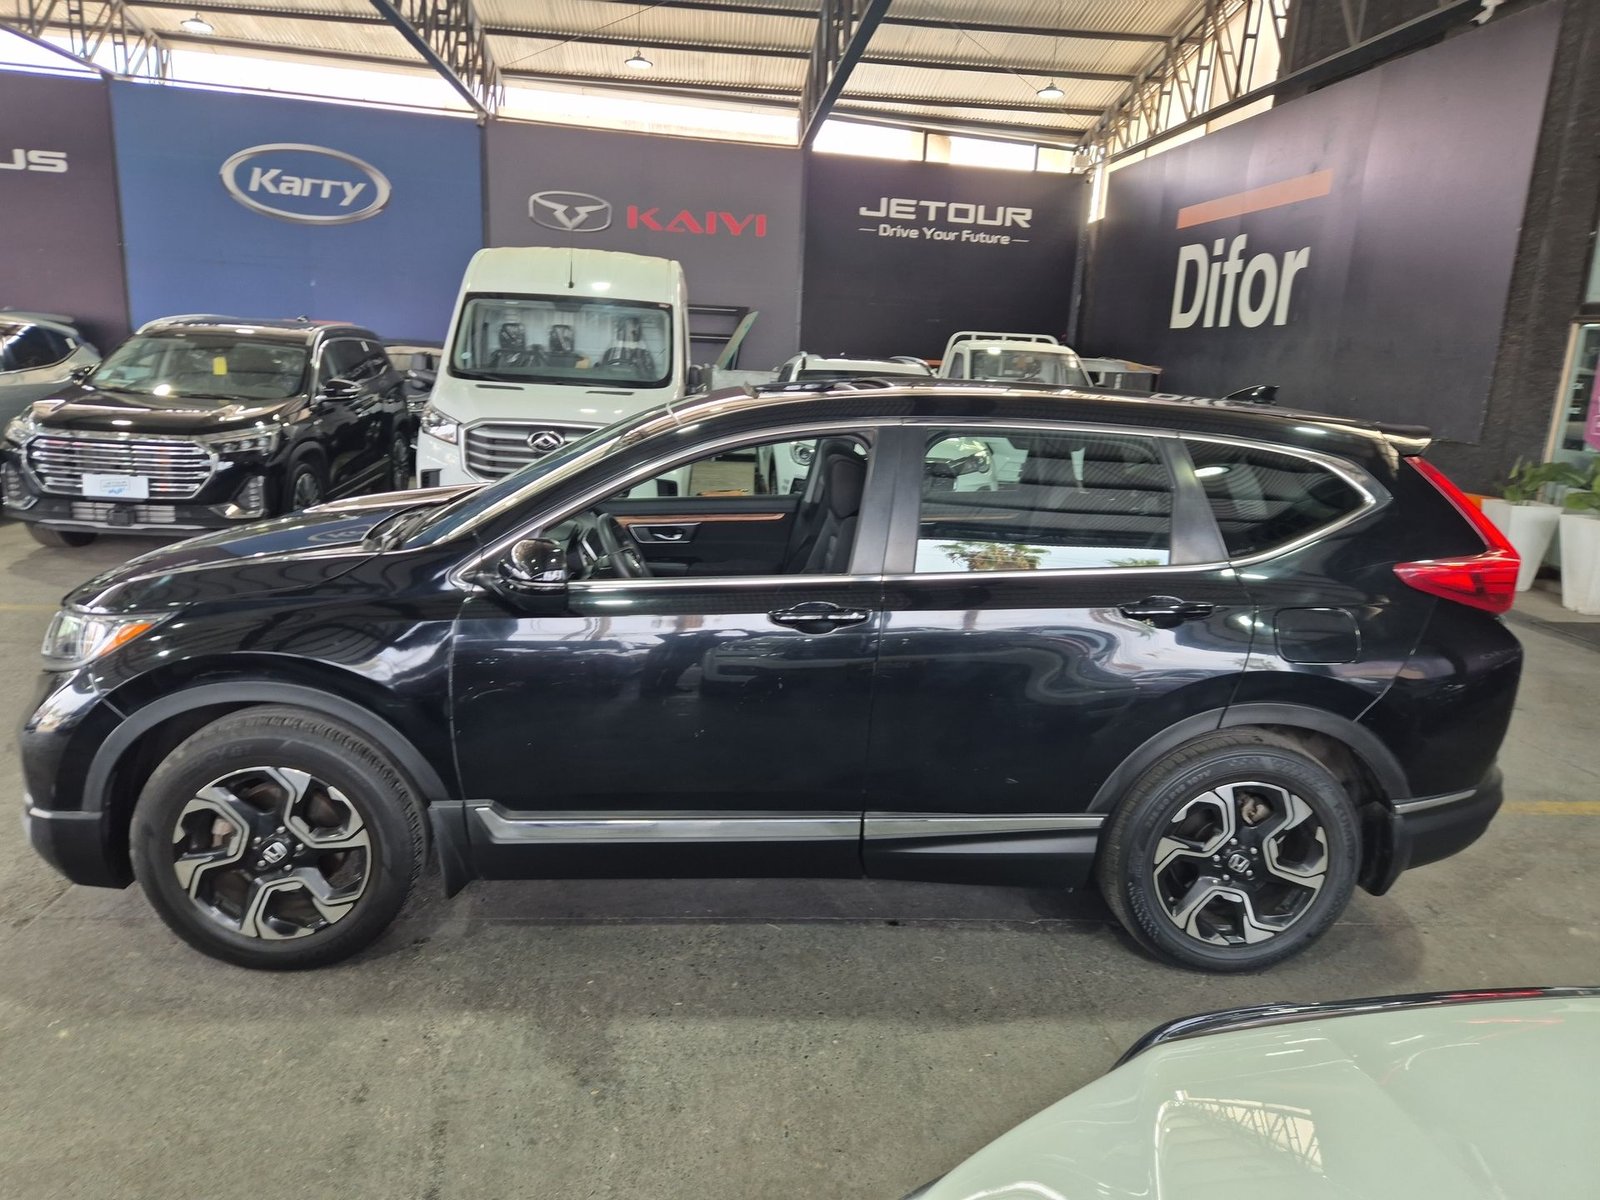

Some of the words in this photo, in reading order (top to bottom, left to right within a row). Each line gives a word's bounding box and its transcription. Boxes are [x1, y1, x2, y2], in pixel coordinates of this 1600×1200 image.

[248, 167, 368, 207] Karry
[626, 205, 767, 238] KAIYI
[858, 197, 1033, 228] JETOUR
[878, 223, 919, 239] Drive
[922, 226, 960, 242] Your
[961, 229, 1011, 245] Future
[1169, 233, 1311, 329] Difor
